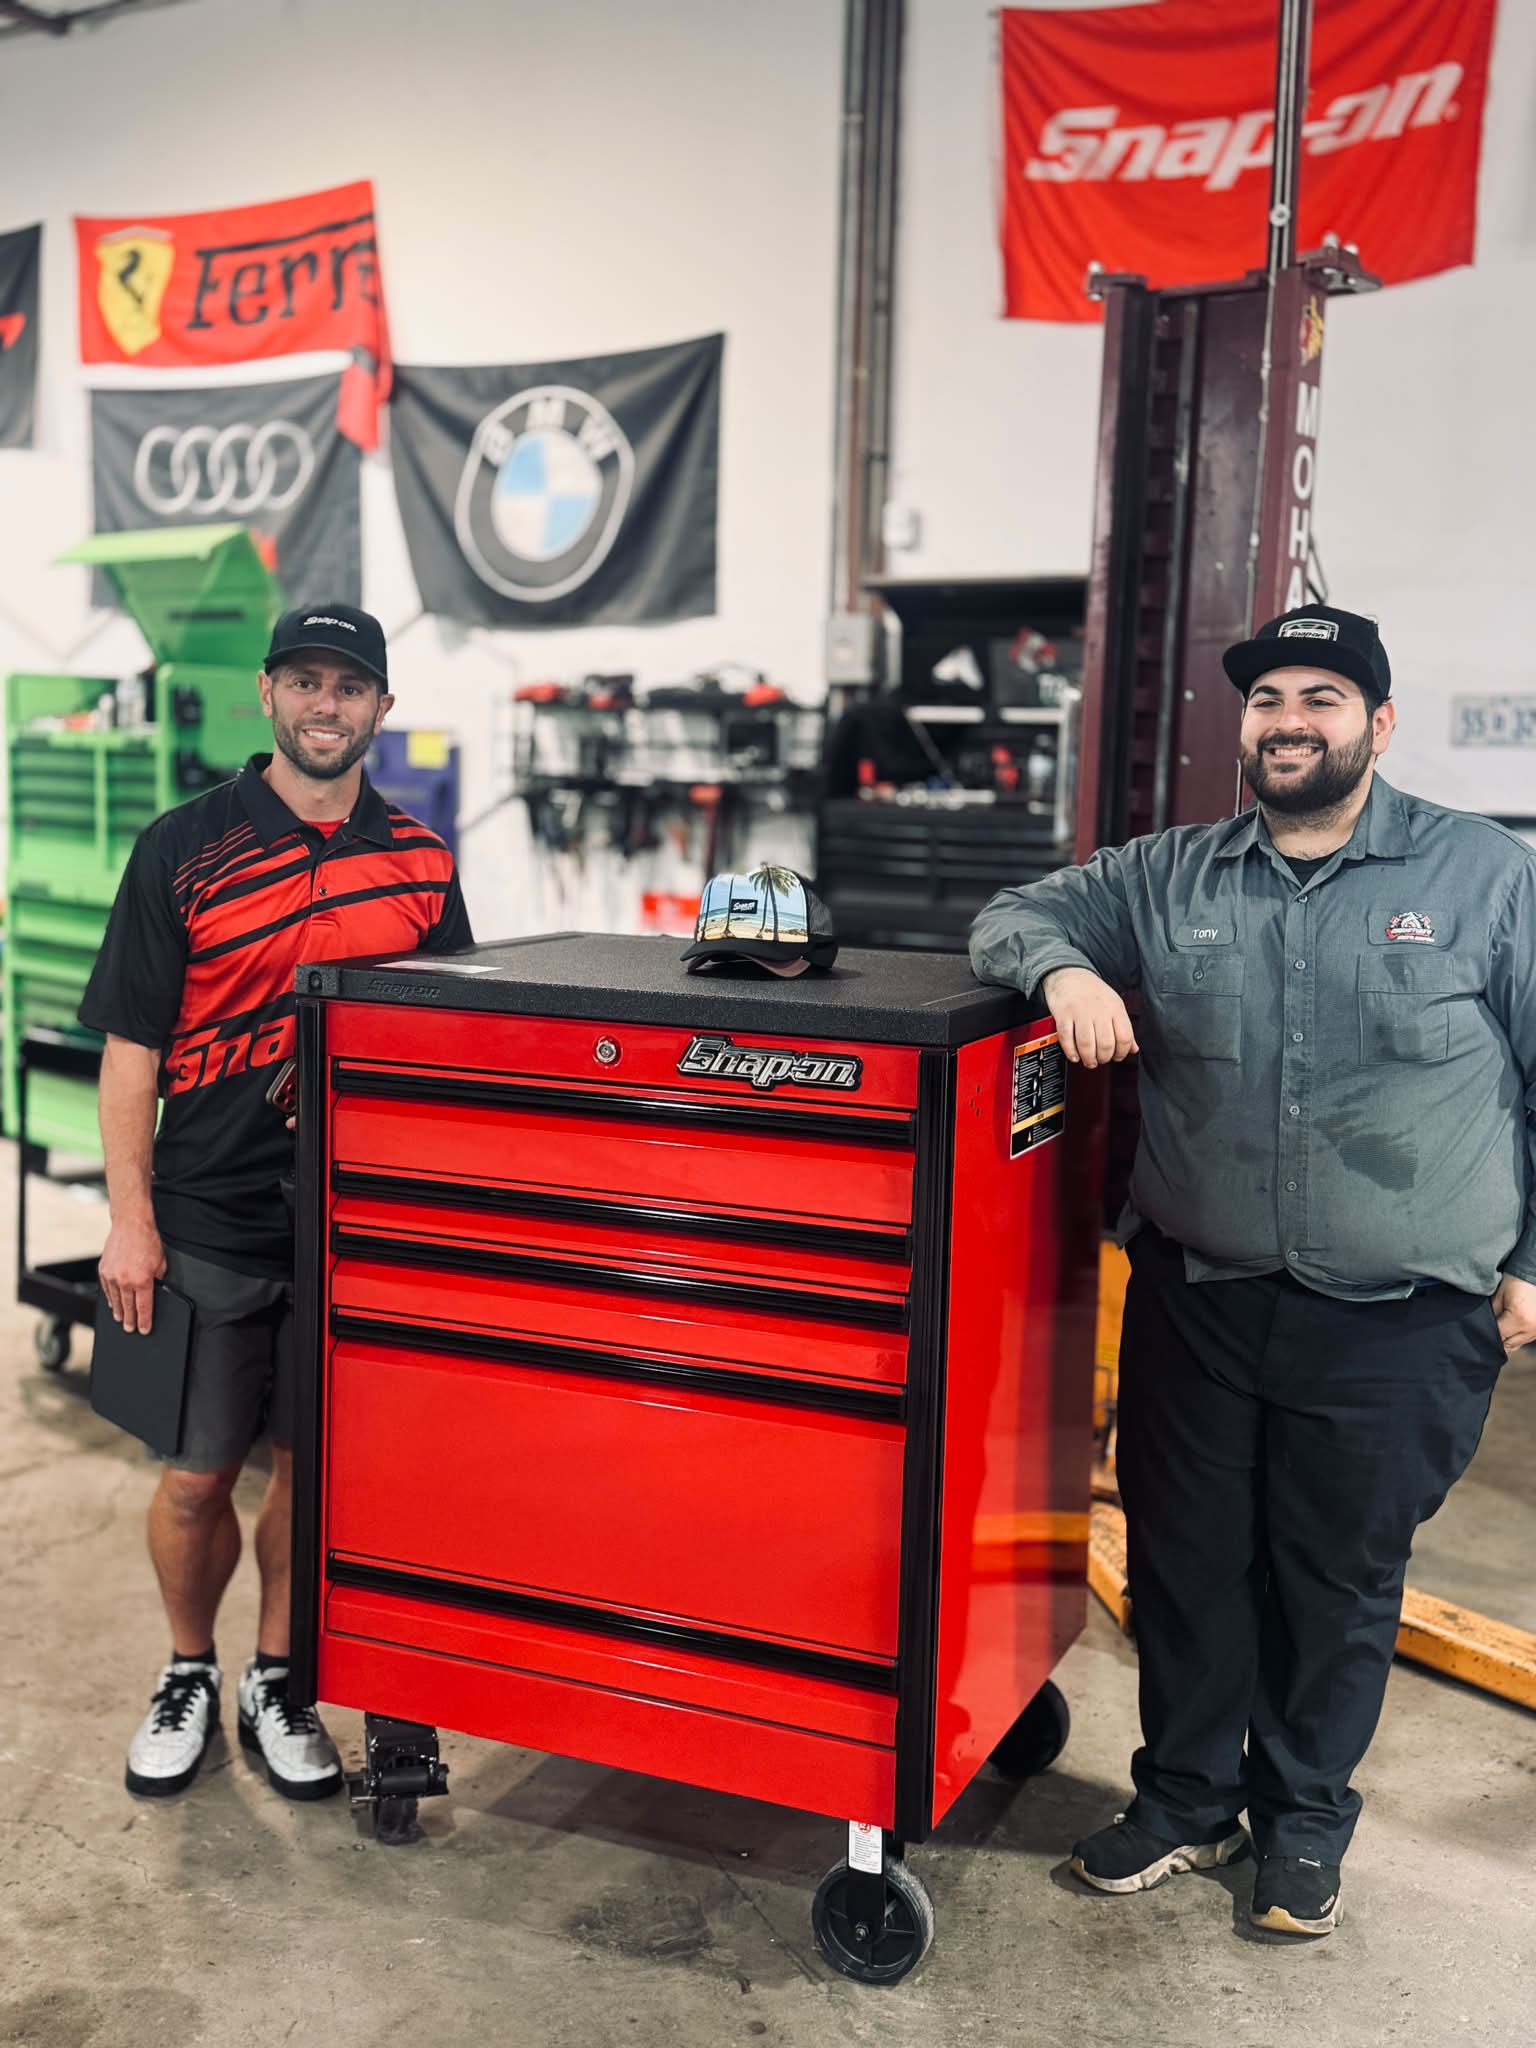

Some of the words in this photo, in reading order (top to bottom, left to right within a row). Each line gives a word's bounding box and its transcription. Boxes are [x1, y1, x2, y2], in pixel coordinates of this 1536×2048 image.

[186, 213, 377, 331] Ferr
[480, 398, 619, 468] BMW
[1192, 929, 1218, 940] Tony
[680, 1039, 857, 1087] Snap-on
